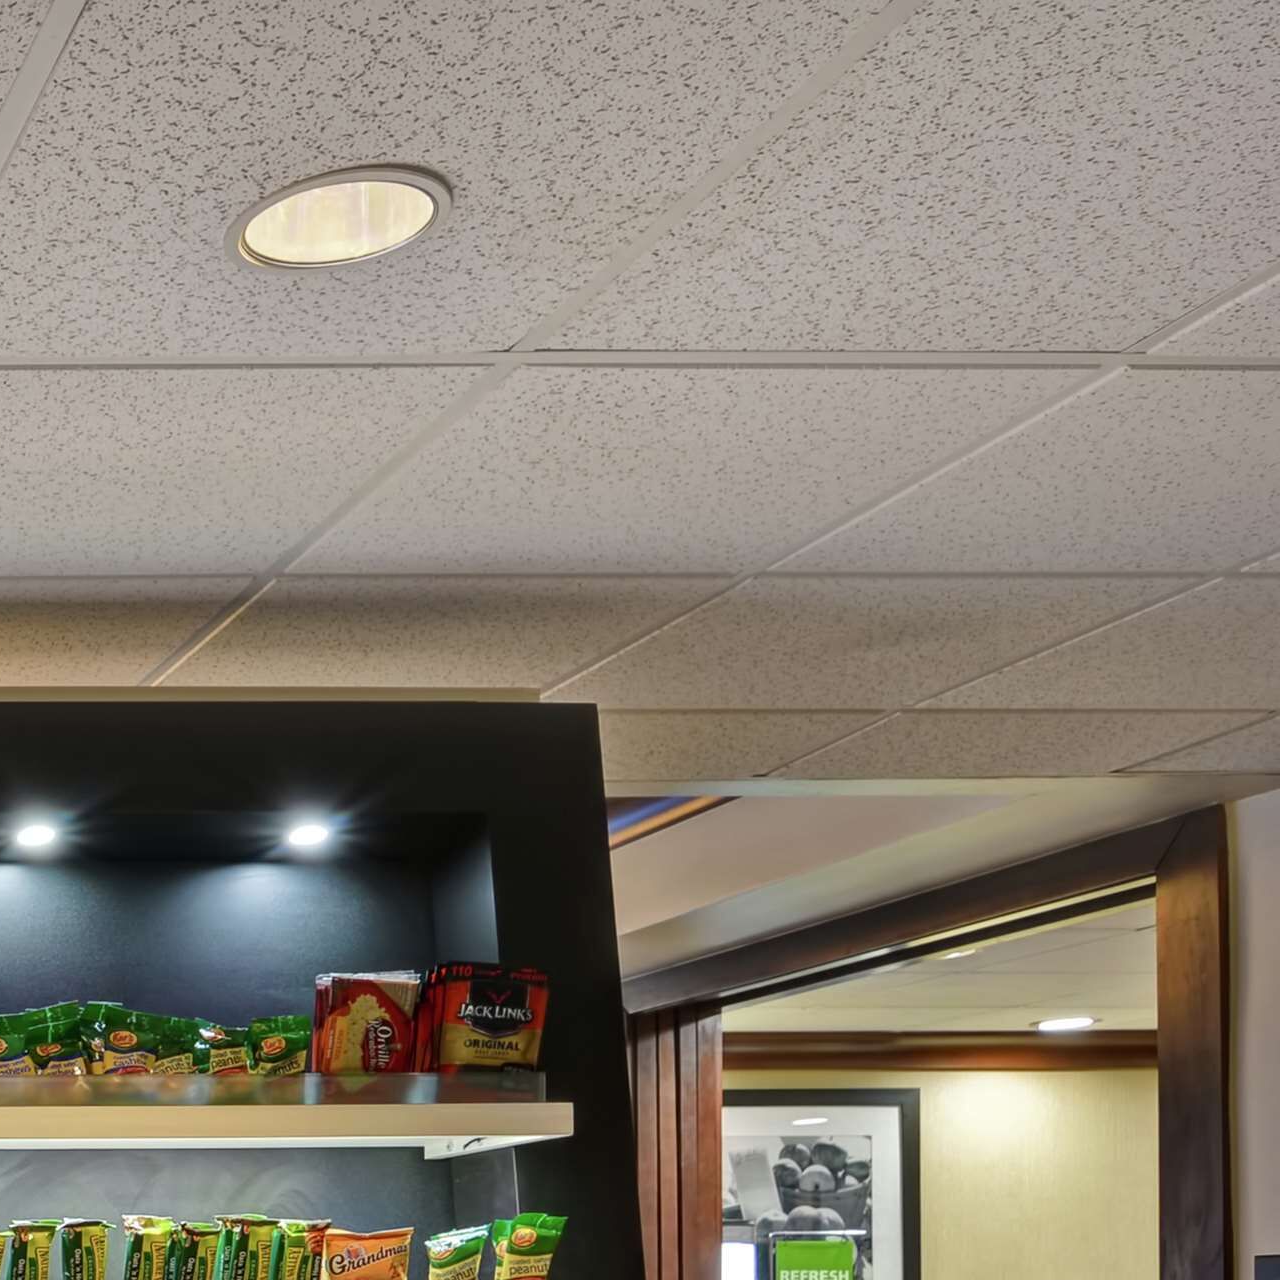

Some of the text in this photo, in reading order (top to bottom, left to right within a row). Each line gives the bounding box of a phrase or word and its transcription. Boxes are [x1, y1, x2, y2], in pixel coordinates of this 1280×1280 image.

[458, 1003, 533, 1025] JACK LINK'S
[376, 1026, 393, 1069] Orville
[463, 1038, 521, 1051] ORIGINAL
[509, 1261, 549, 1277] peanut
